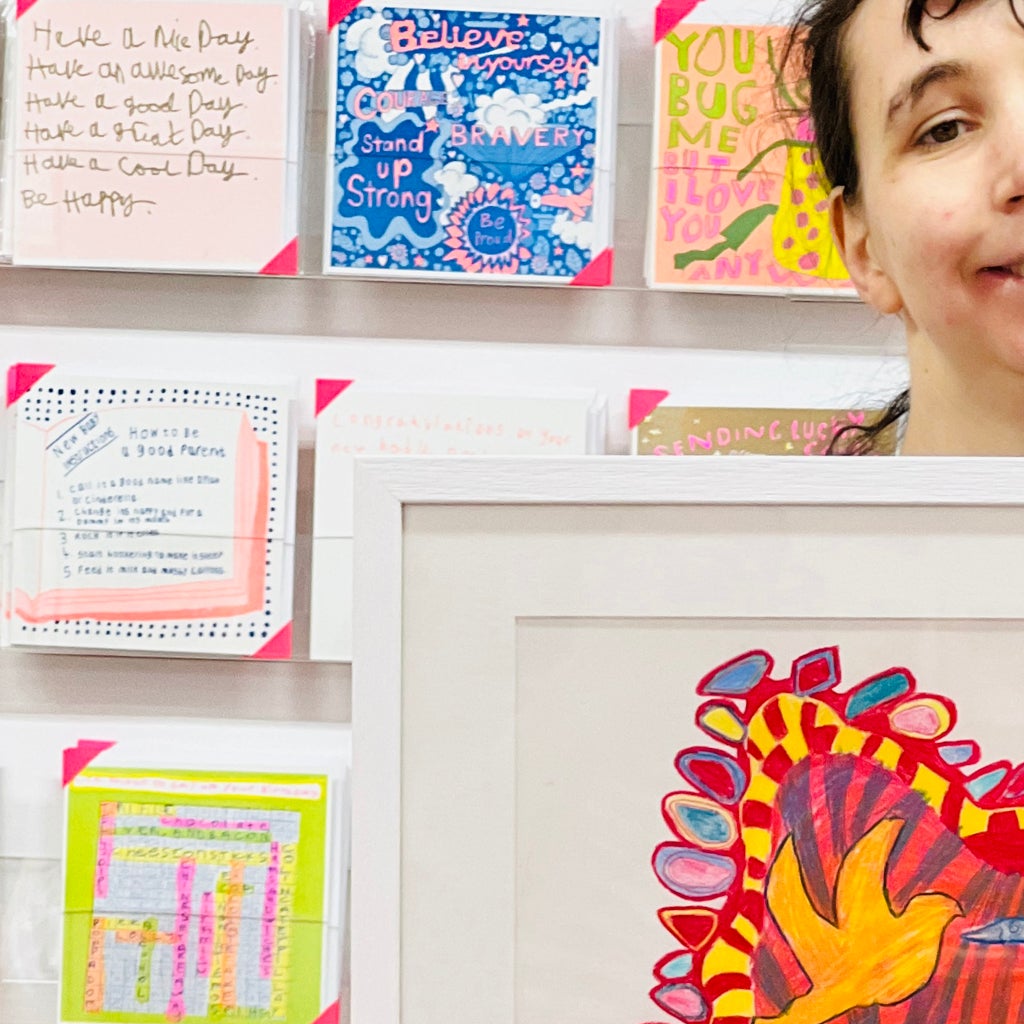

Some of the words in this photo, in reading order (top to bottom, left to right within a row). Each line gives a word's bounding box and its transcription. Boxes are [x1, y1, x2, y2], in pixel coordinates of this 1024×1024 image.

[122, 26, 146, 49] a
[390, 20, 524, 52] Believe
[665, 27, 755, 76] YOU
[27, 53, 93, 80] Have
[98, 62, 125, 84] an
[131, 61, 229, 84] awesome
[481, 50, 590, 88] yourself
[25, 91, 85, 113] Have
[95, 93, 118, 109] a
[124, 92, 181, 116] good
[668, 73, 757, 125] BUG
[24, 119, 84, 143] Have
[89, 121, 107, 137] a
[114, 120, 183, 147] great
[361, 131, 424, 153] Stand
[451, 123, 586, 147] BRAVERY
[668, 119, 739, 153] ME
[23, 154, 84, 175] Have
[89, 158, 110, 171] a
[376, 158, 413, 189] up
[663, 150, 730, 183] BUT
[21, 190, 57, 208] Be
[347, 174, 432, 223] Strong
[666, 179, 677, 203] I
[686, 177, 776, 212] LOVE
[480, 213, 505, 229] Be
[661, 206, 720, 243] YOU
[475, 231, 513, 246] Proud
[121, 445, 130, 457] a
